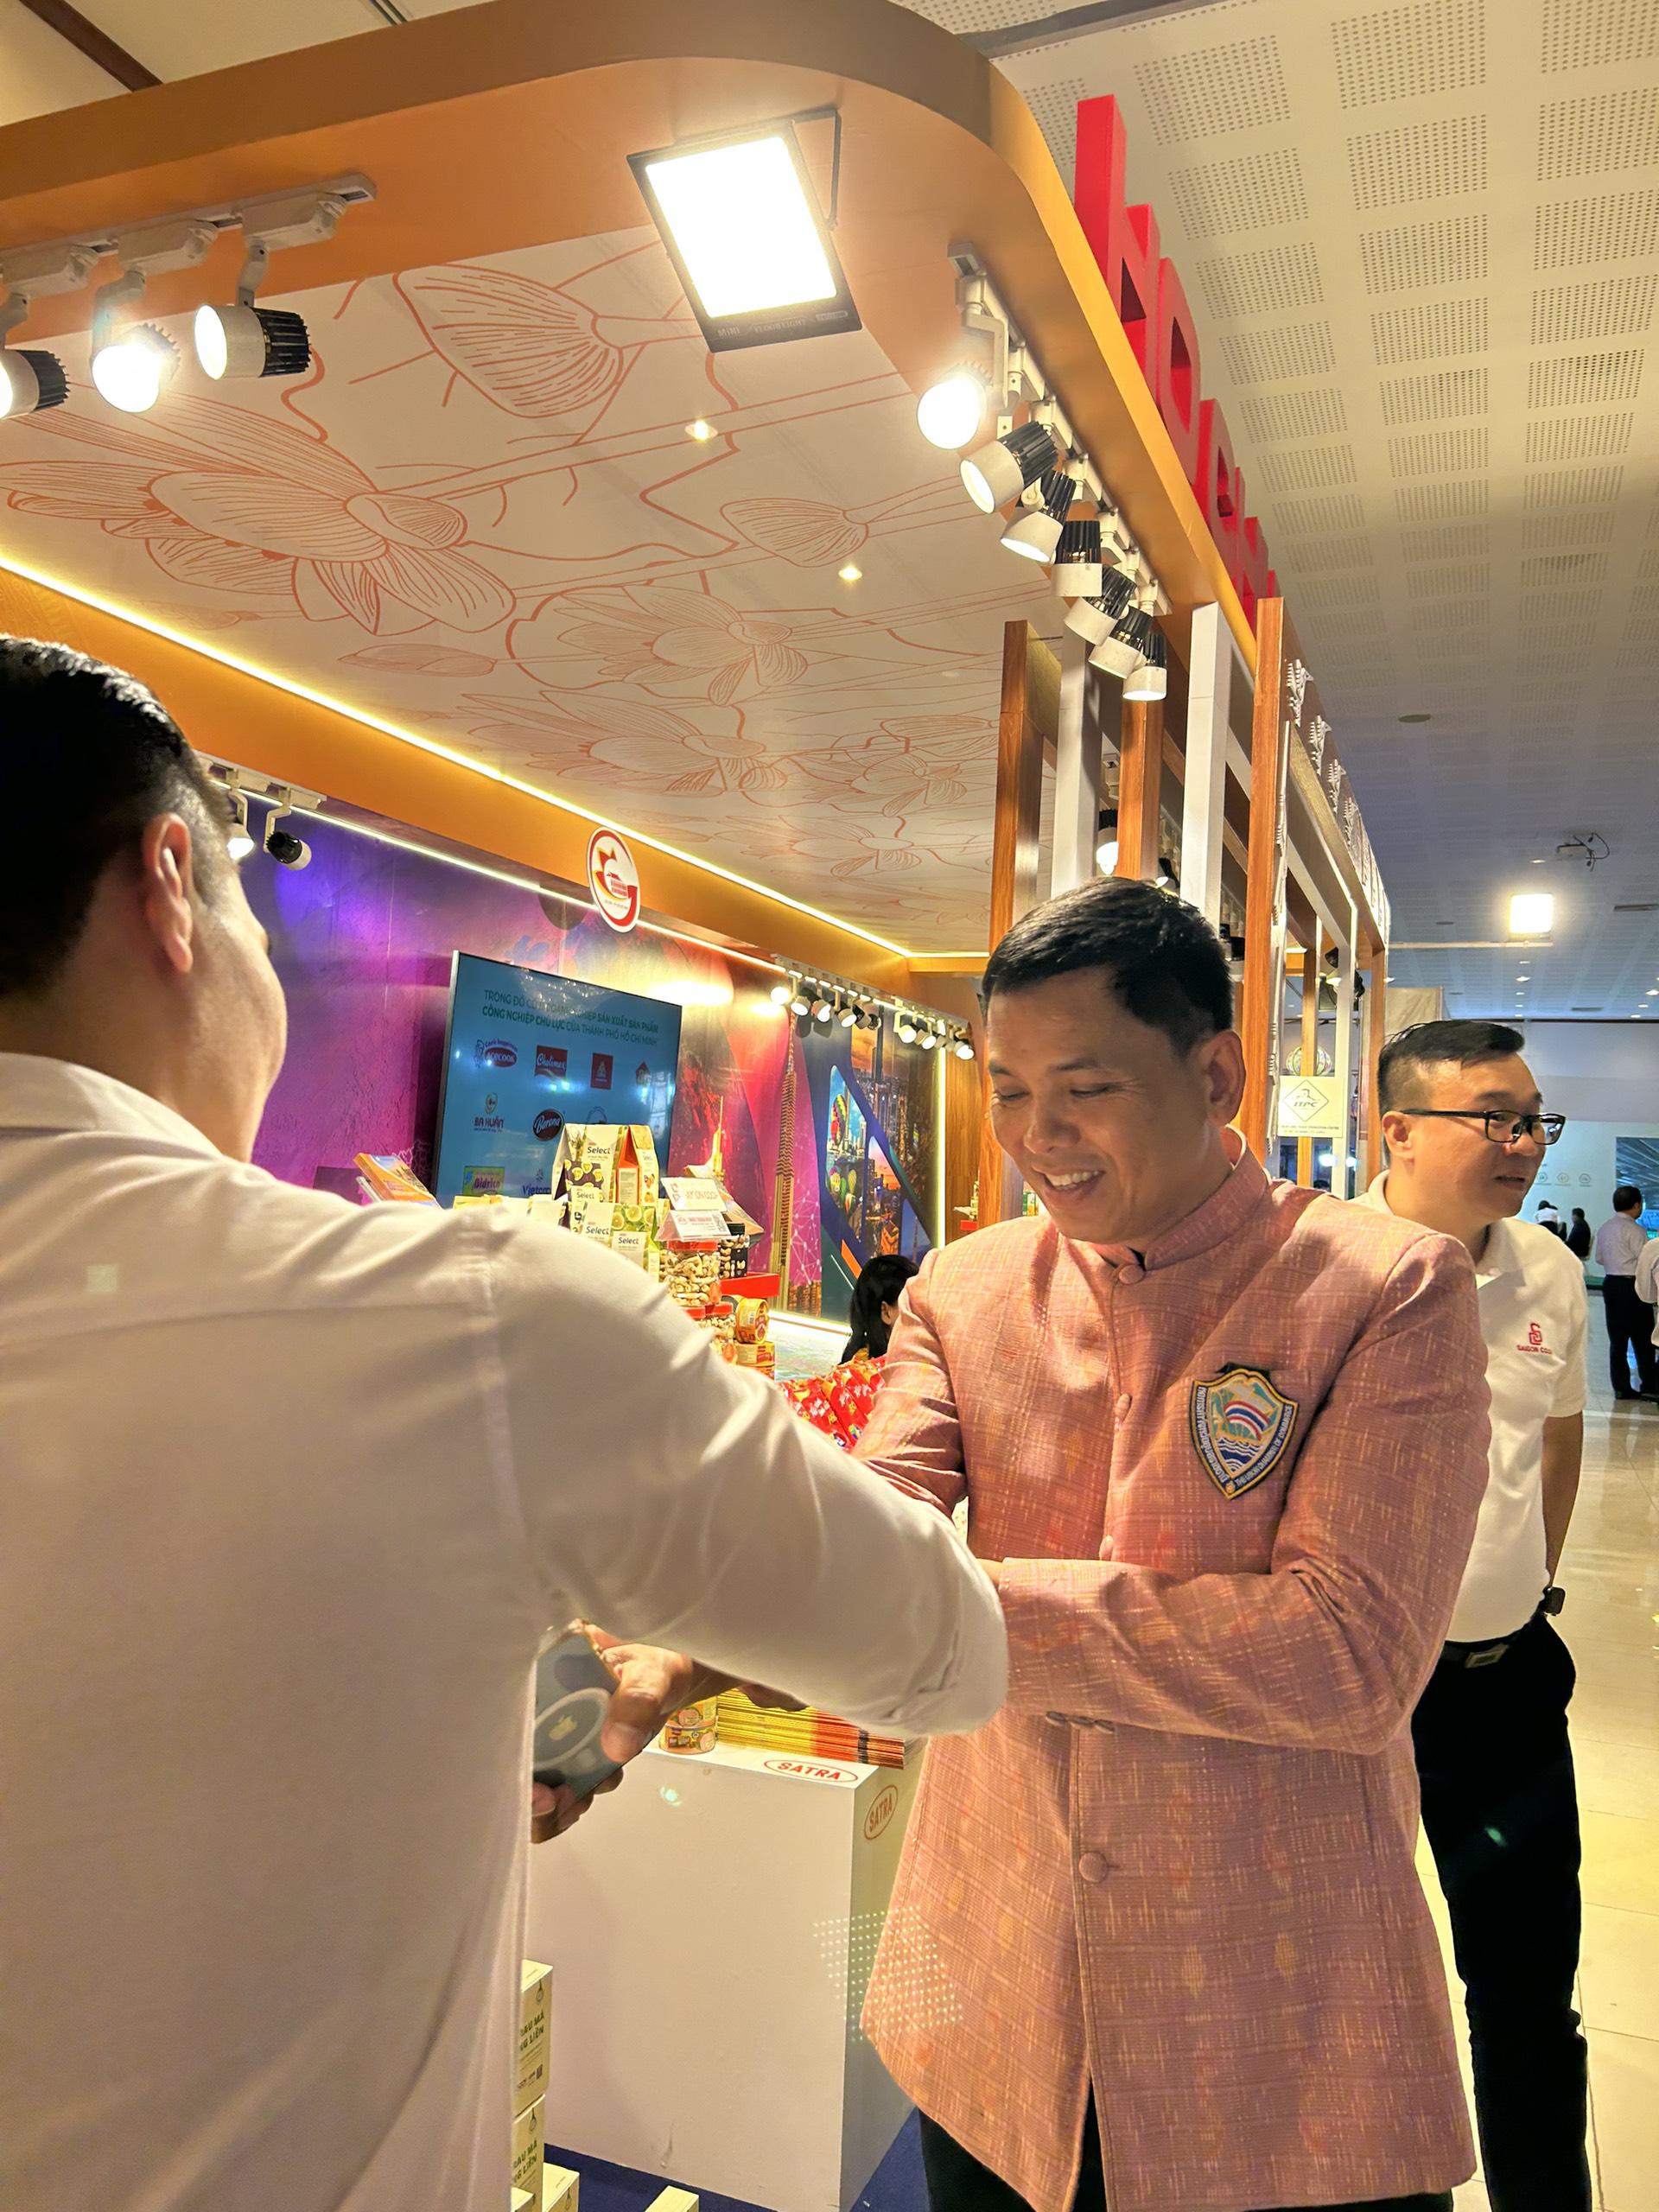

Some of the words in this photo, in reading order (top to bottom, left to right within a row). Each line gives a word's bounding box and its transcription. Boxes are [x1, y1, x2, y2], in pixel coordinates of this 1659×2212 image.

[484, 989, 512, 1004] TRONG
[482, 1003, 505, 1019] CÔNG
[506, 1010, 535, 1026] NGHIỆP
[588, 1146, 611, 1154] Select
[586, 1226, 609, 1235] Select
[777, 1762, 841, 1780] SATRA
[869, 1793, 893, 1833] SATRA
